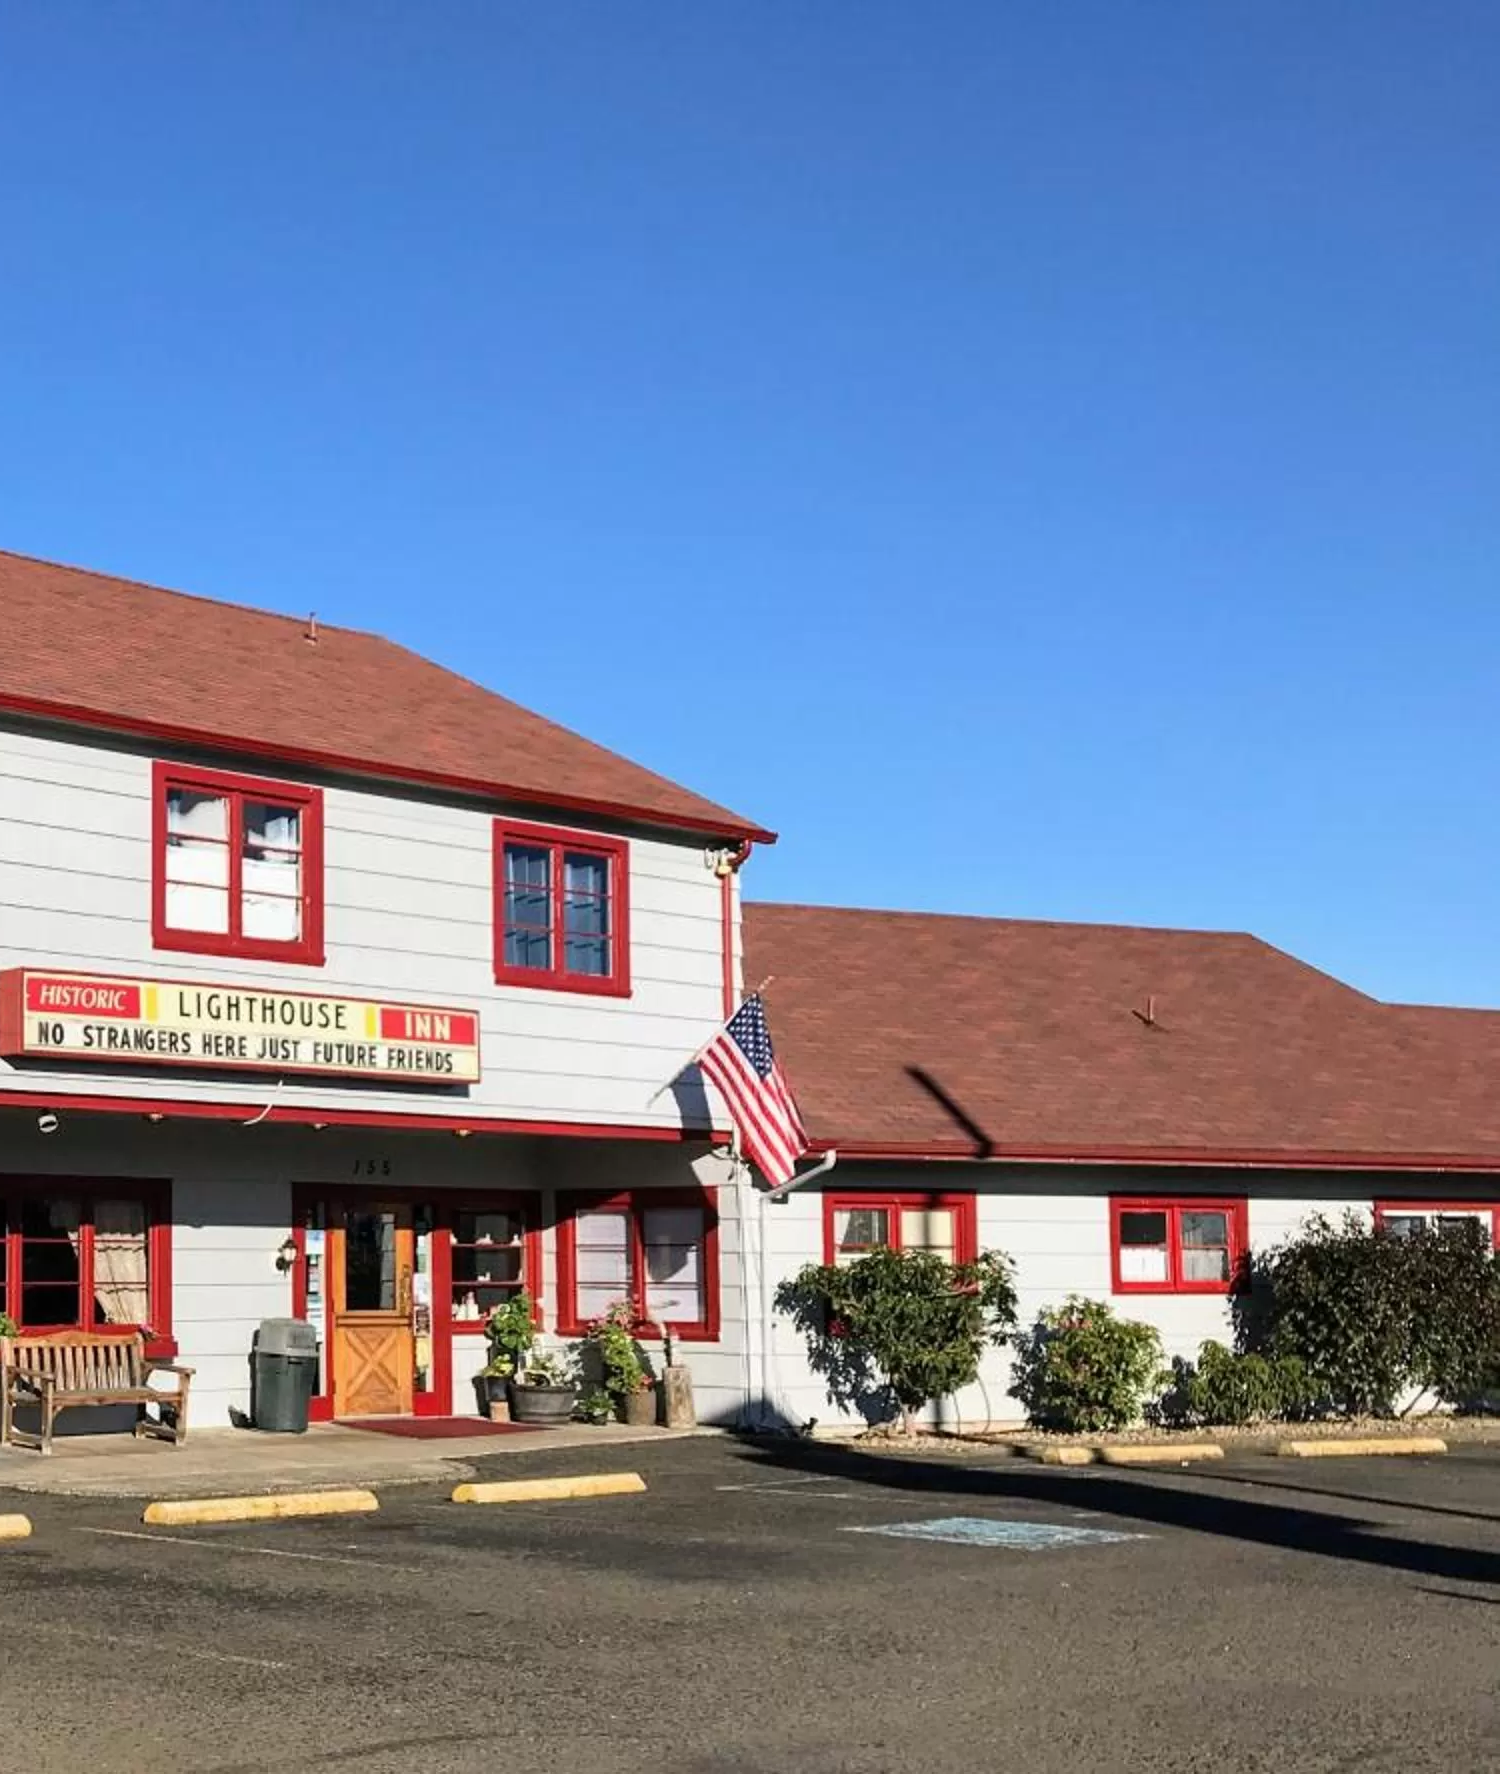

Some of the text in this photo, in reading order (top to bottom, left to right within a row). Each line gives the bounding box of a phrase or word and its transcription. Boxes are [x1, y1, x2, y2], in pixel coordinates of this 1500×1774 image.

[40, 985, 451, 1040] HISTORIC LIGHTHOUSE INN
[38, 1021, 453, 1073] NO STRANGERS HERE JUST FUTURE FRIENDS
[353, 1159, 391, 1177] 155
